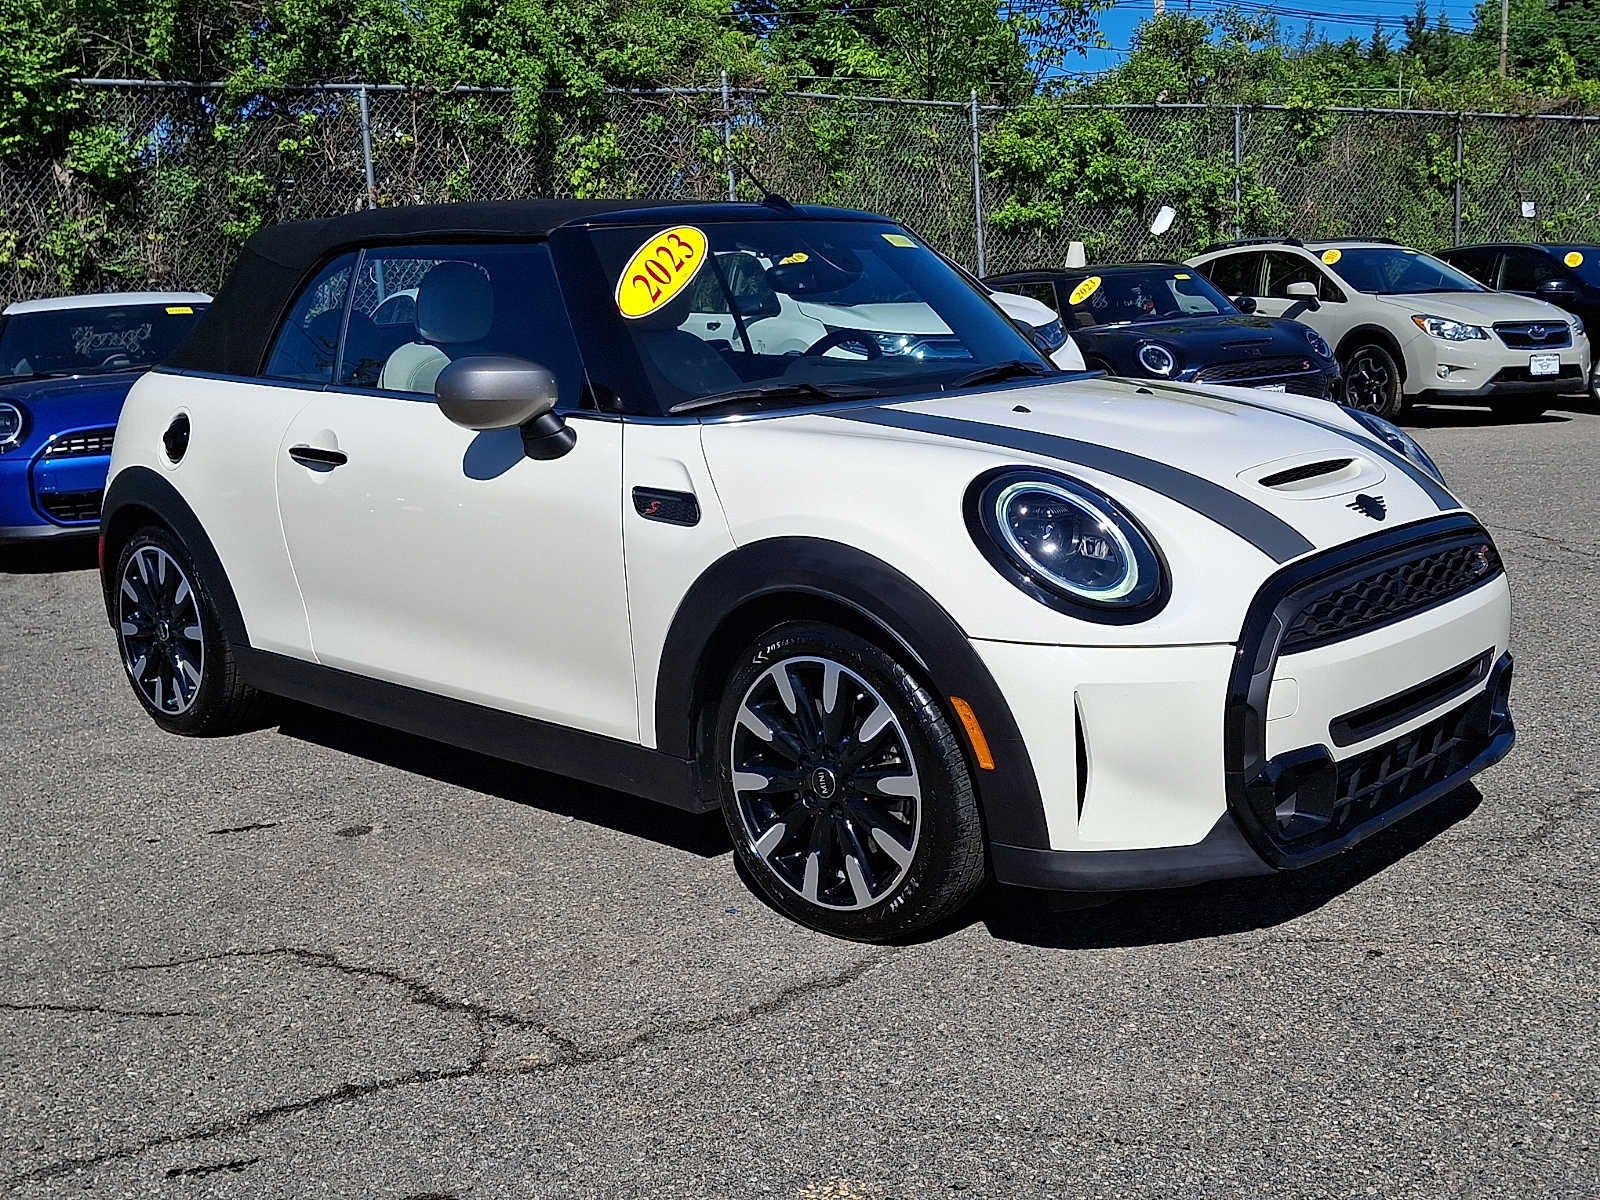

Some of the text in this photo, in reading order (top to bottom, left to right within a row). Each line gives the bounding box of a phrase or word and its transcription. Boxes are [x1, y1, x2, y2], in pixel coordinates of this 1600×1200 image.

[632, 233, 695, 304] 2023
[1075, 279, 1097, 300] 2023
[644, 499, 662, 515] S
[817, 771, 829, 795] MINI
